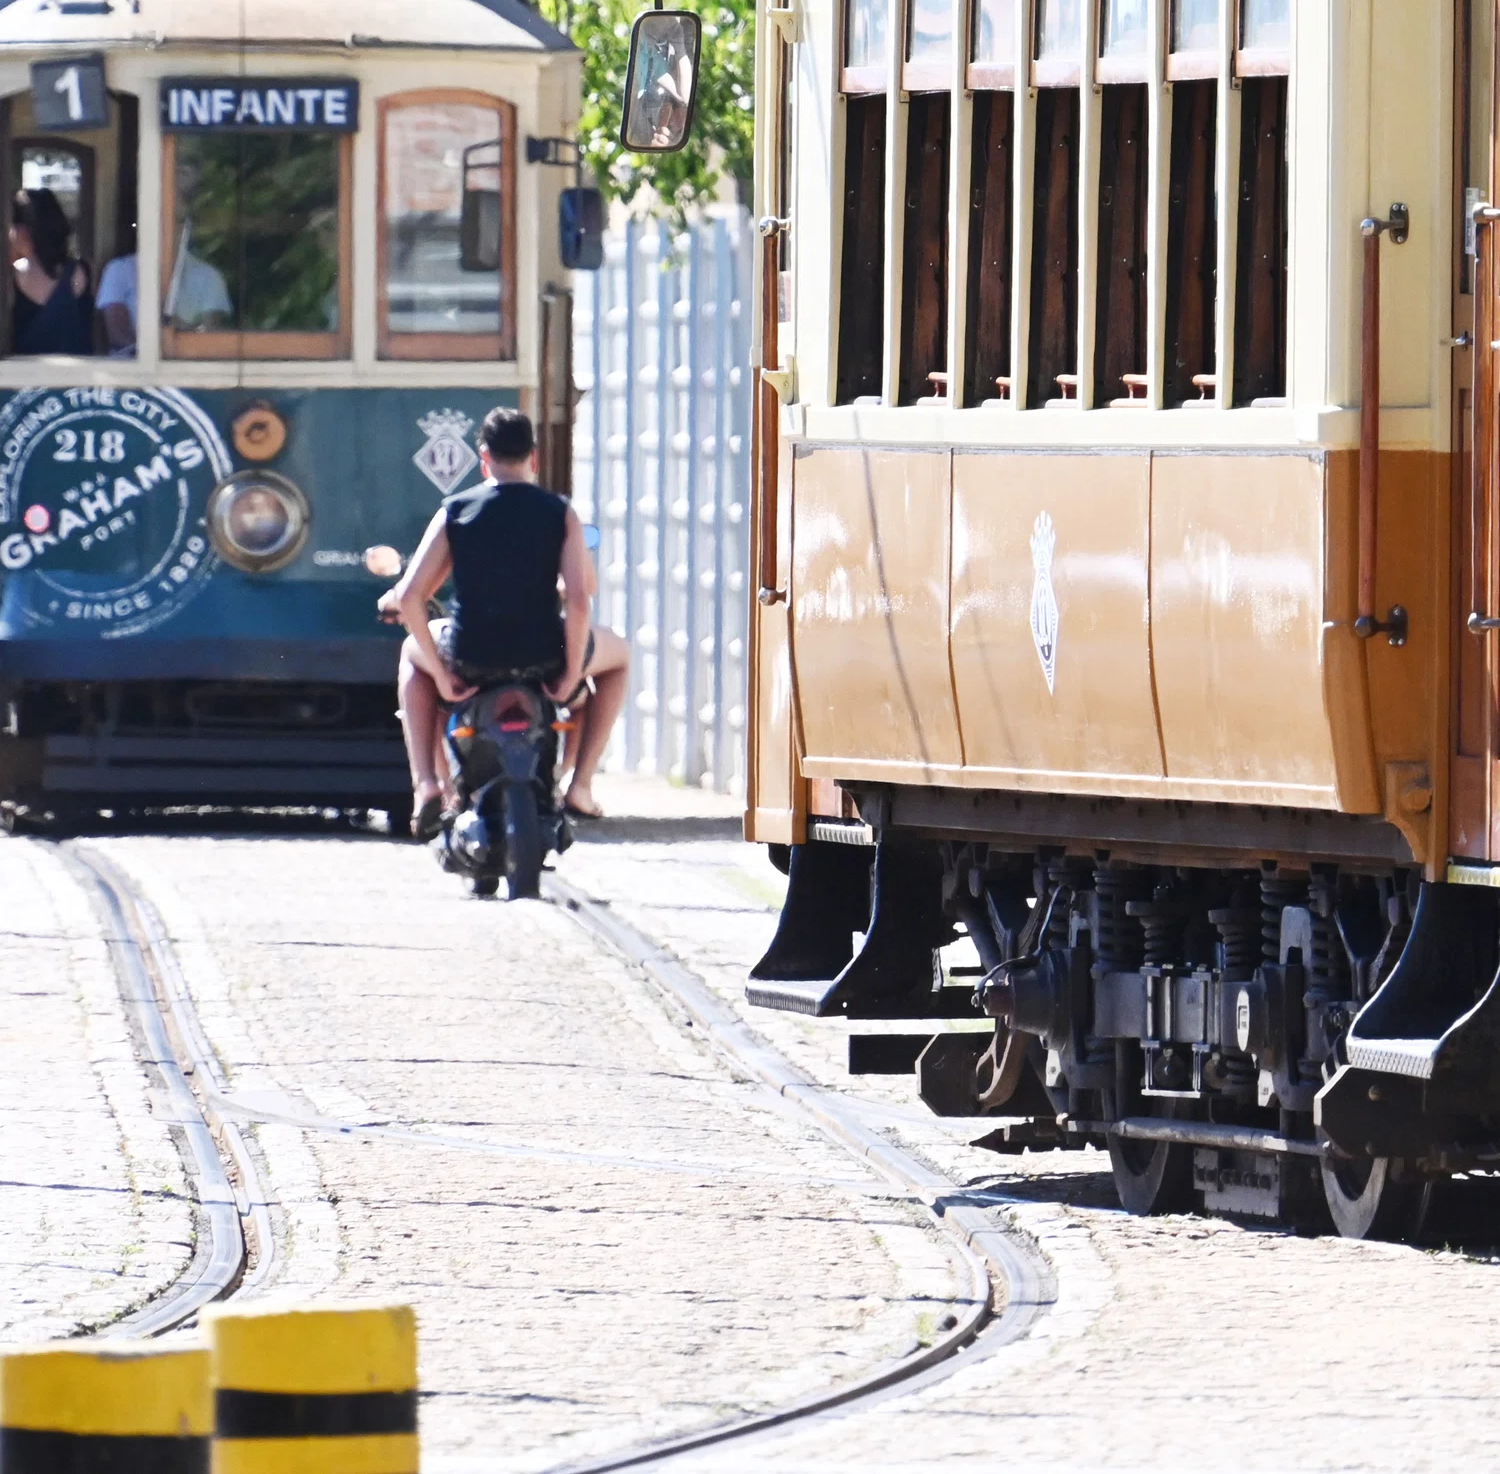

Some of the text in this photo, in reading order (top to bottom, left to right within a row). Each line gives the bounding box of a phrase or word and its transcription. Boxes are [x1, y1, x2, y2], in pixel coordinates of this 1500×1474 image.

[54, 66, 83, 121] 1
[168, 88, 349, 124] INFANTE
[65, 386, 116, 409] THE
[120, 392, 179, 429] CITY
[53, 428, 126, 464] 218
[80, 509, 136, 552] PORT
[65, 590, 152, 621] SINCE
